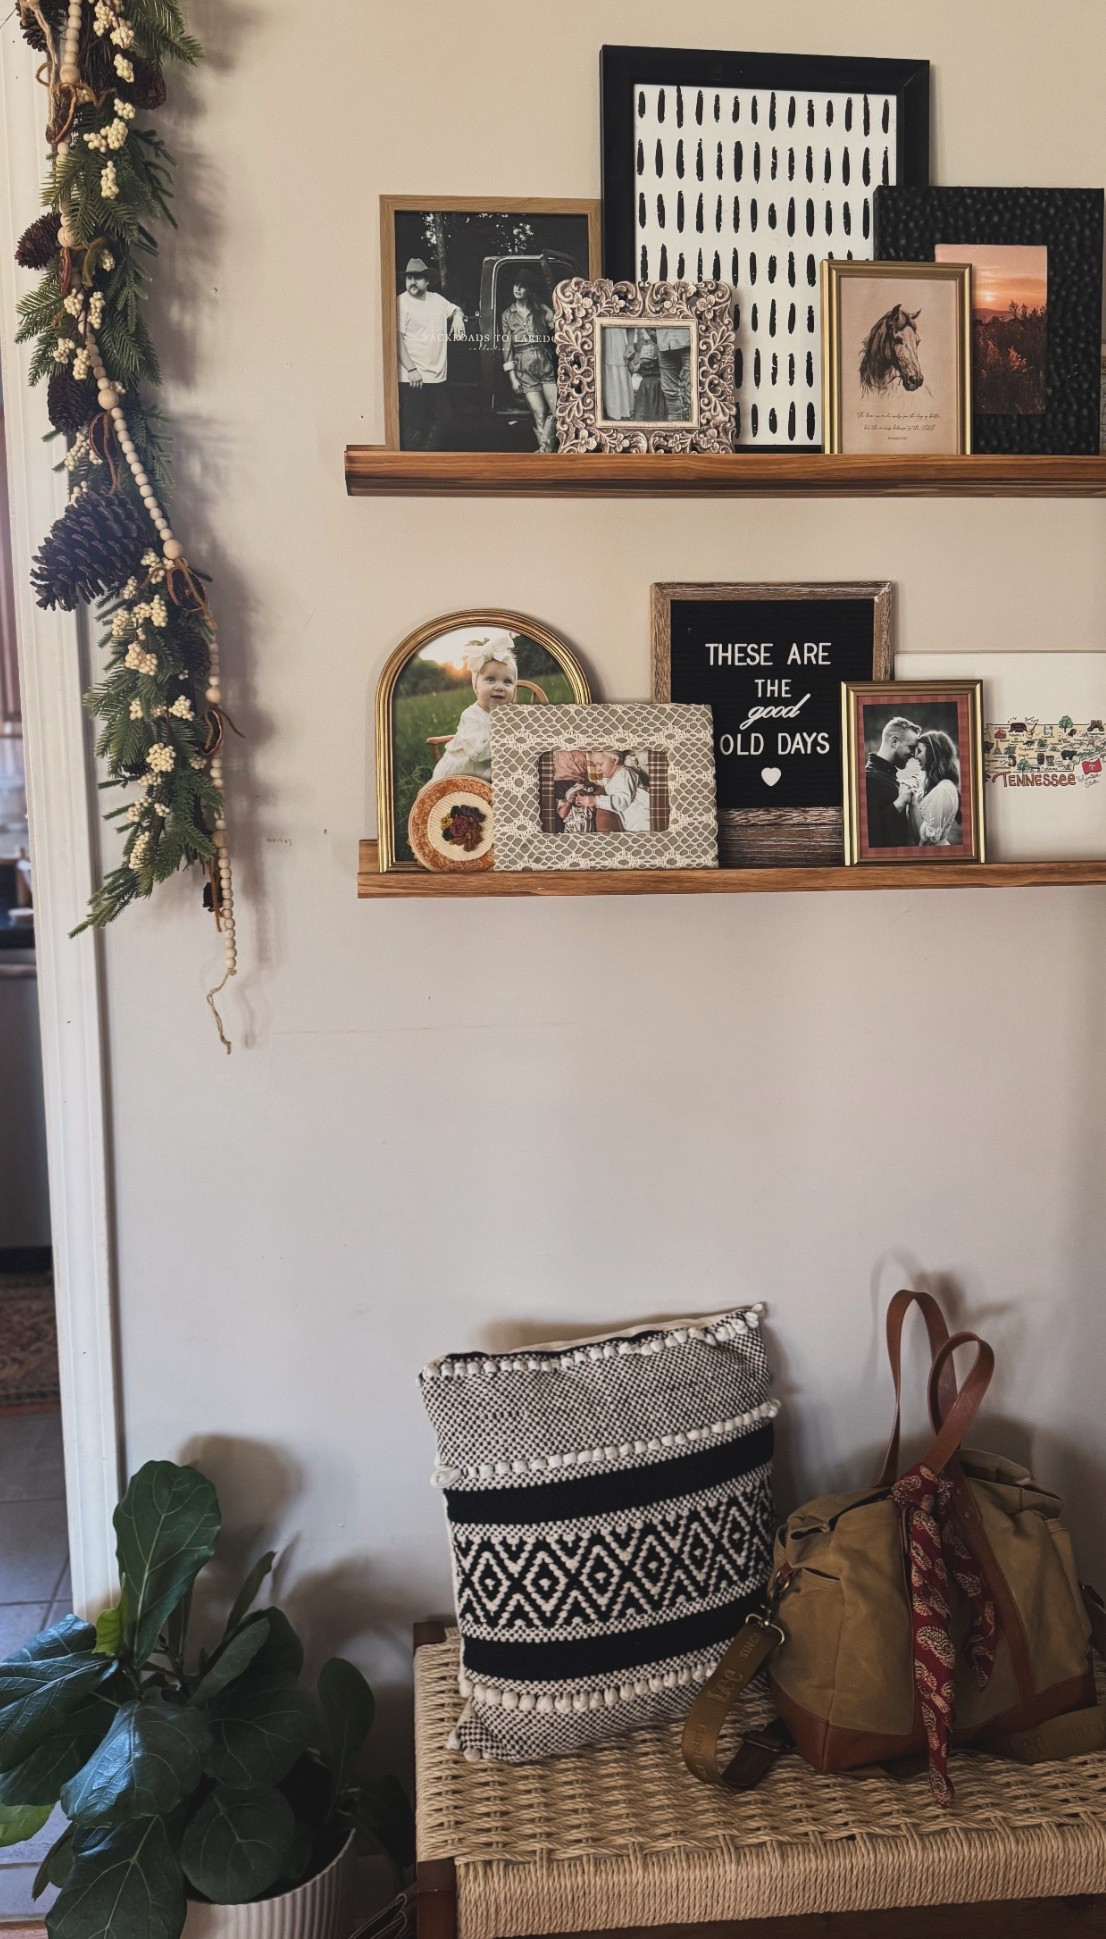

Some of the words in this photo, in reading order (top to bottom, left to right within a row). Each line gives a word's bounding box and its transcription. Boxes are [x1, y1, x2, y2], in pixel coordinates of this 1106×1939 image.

[495, 333, 510, 343] TO
[705, 643, 774, 666] THESE
[787, 642, 832, 665] ARE
[754, 679, 792, 698] THE
[739, 693, 811, 730] good
[719, 733, 765, 756] OLD
[777, 731, 830, 755] DAYS
